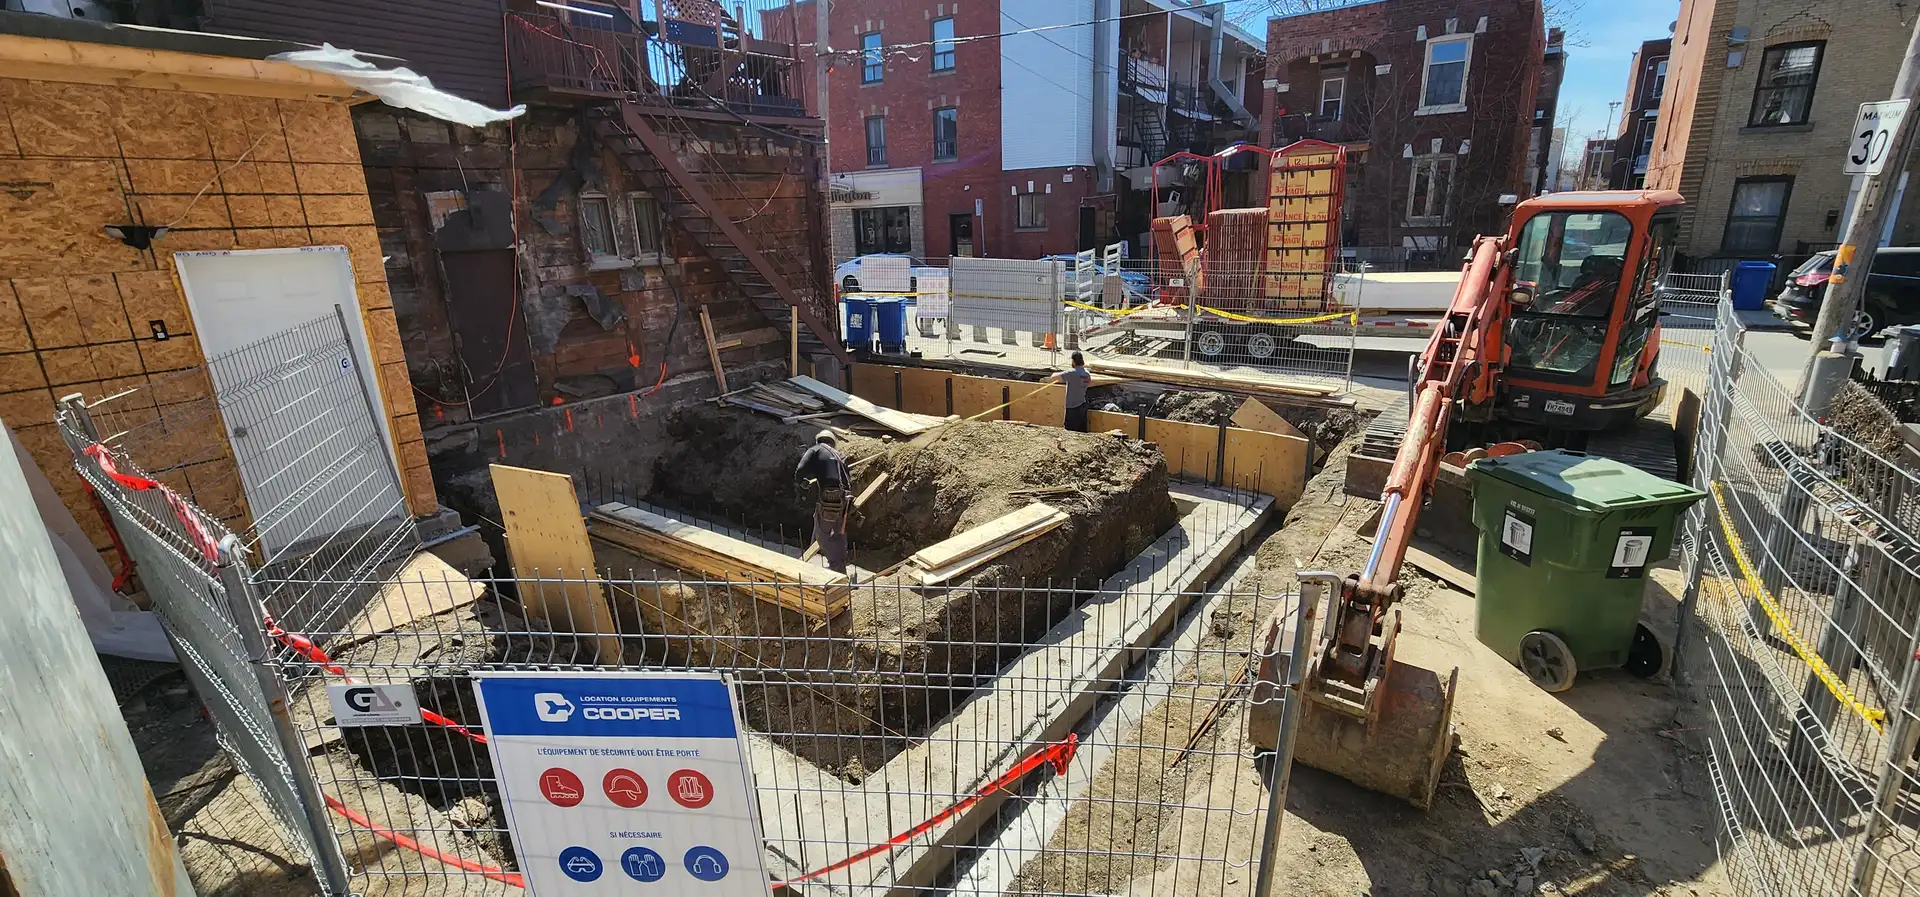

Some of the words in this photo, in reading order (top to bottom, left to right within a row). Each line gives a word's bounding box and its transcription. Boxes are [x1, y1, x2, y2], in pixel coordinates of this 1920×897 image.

[1851, 129, 1889, 165] 30
[583, 707, 681, 720] COOPER
[537, 747, 588, 756] L'ÉQUIPEMENT
[590, 748, 600, 756] DE
[600, 747, 636, 757] SÉCURITÉ
[637, 749, 654, 757] DOIT
[656, 748, 675, 757] ÊTRE
[676, 748, 700, 757] PORTÉ
[619, 830, 663, 839] NÉCESSAIRE
